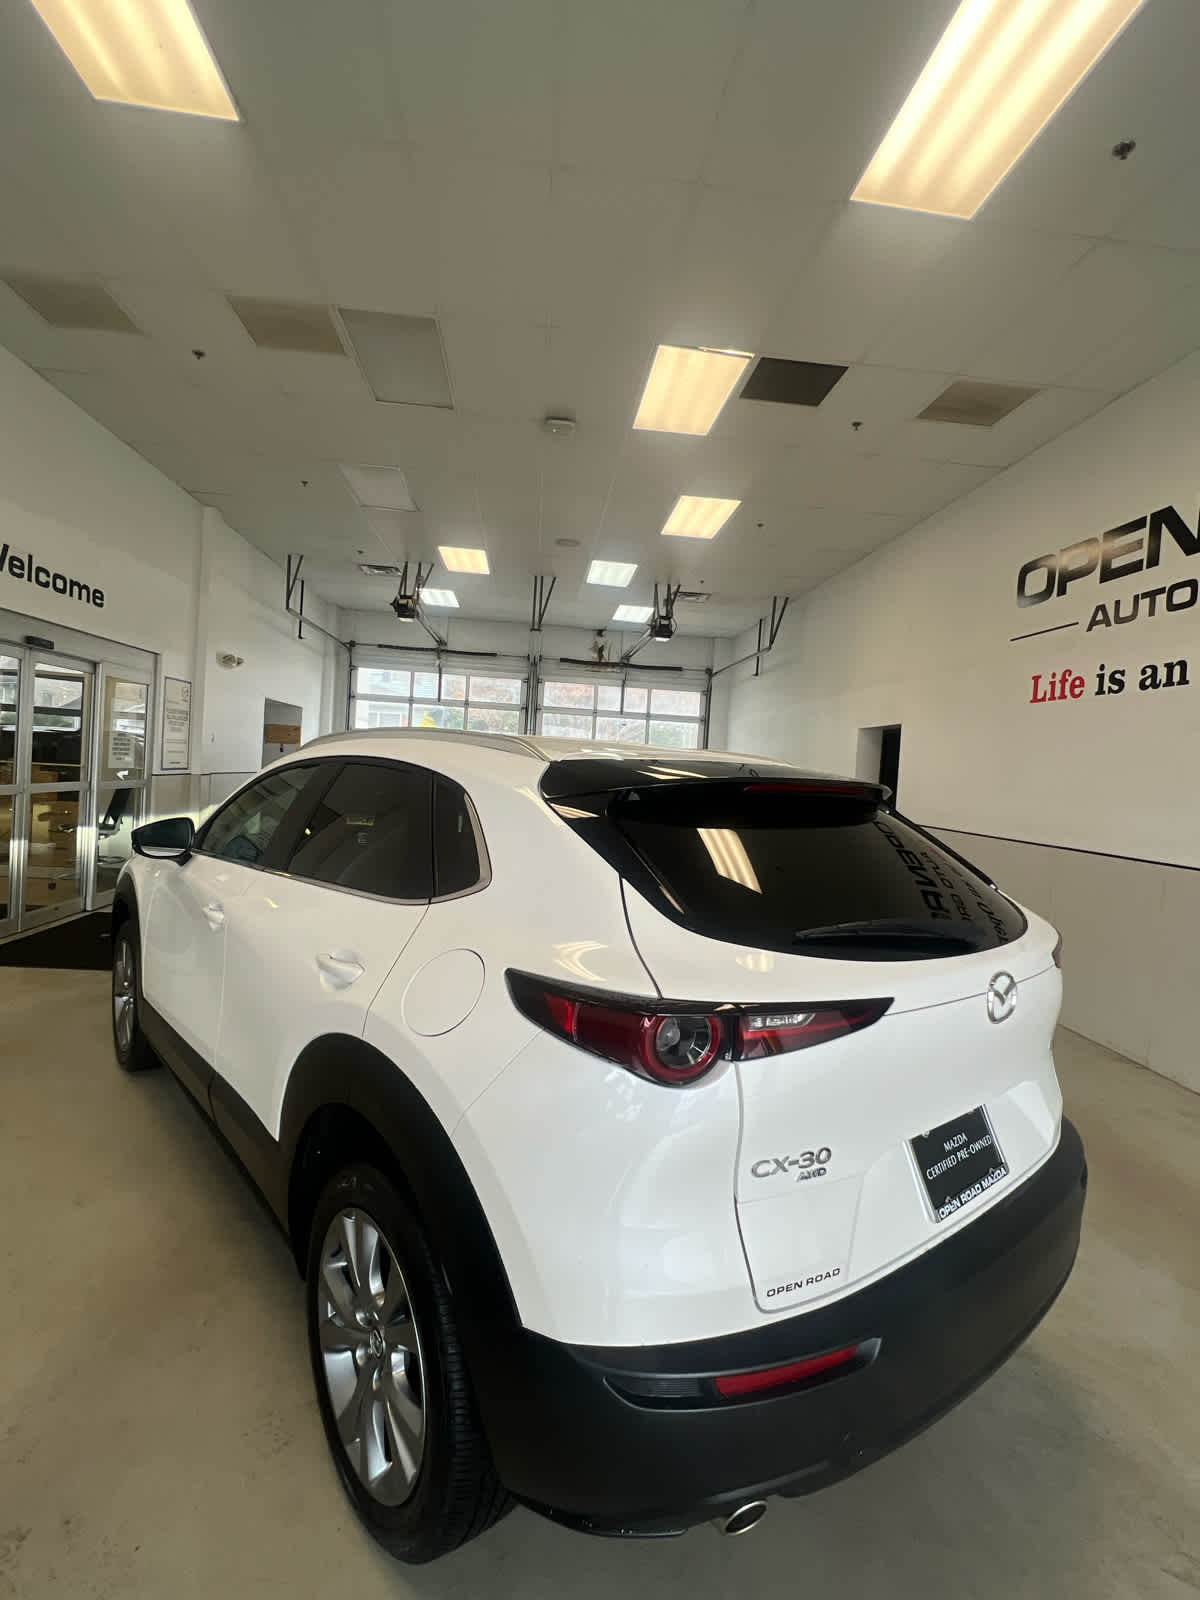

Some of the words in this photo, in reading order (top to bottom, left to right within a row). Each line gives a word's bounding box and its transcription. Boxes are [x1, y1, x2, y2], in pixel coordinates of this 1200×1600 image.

[1016, 504, 1200, 608] OPEN
[1085, 578, 1199, 633] AUTO
[1029, 668, 1085, 704] Life
[1094, 663, 1126, 696] is
[1138, 658, 1190, 691] an
[751, 1147, 832, 1178] CX-30
[926, 1154, 957, 1180] CERTIFIED
[956, 1134, 992, 1161] PRE-OWNED
[943, 1132, 968, 1152] MAZDA
[939, 1198, 961, 1219] OPEN
[960, 1183, 983, 1204] ROAD
[766, 1280, 803, 1298] OPEN
[805, 1267, 841, 1286] ROAD
